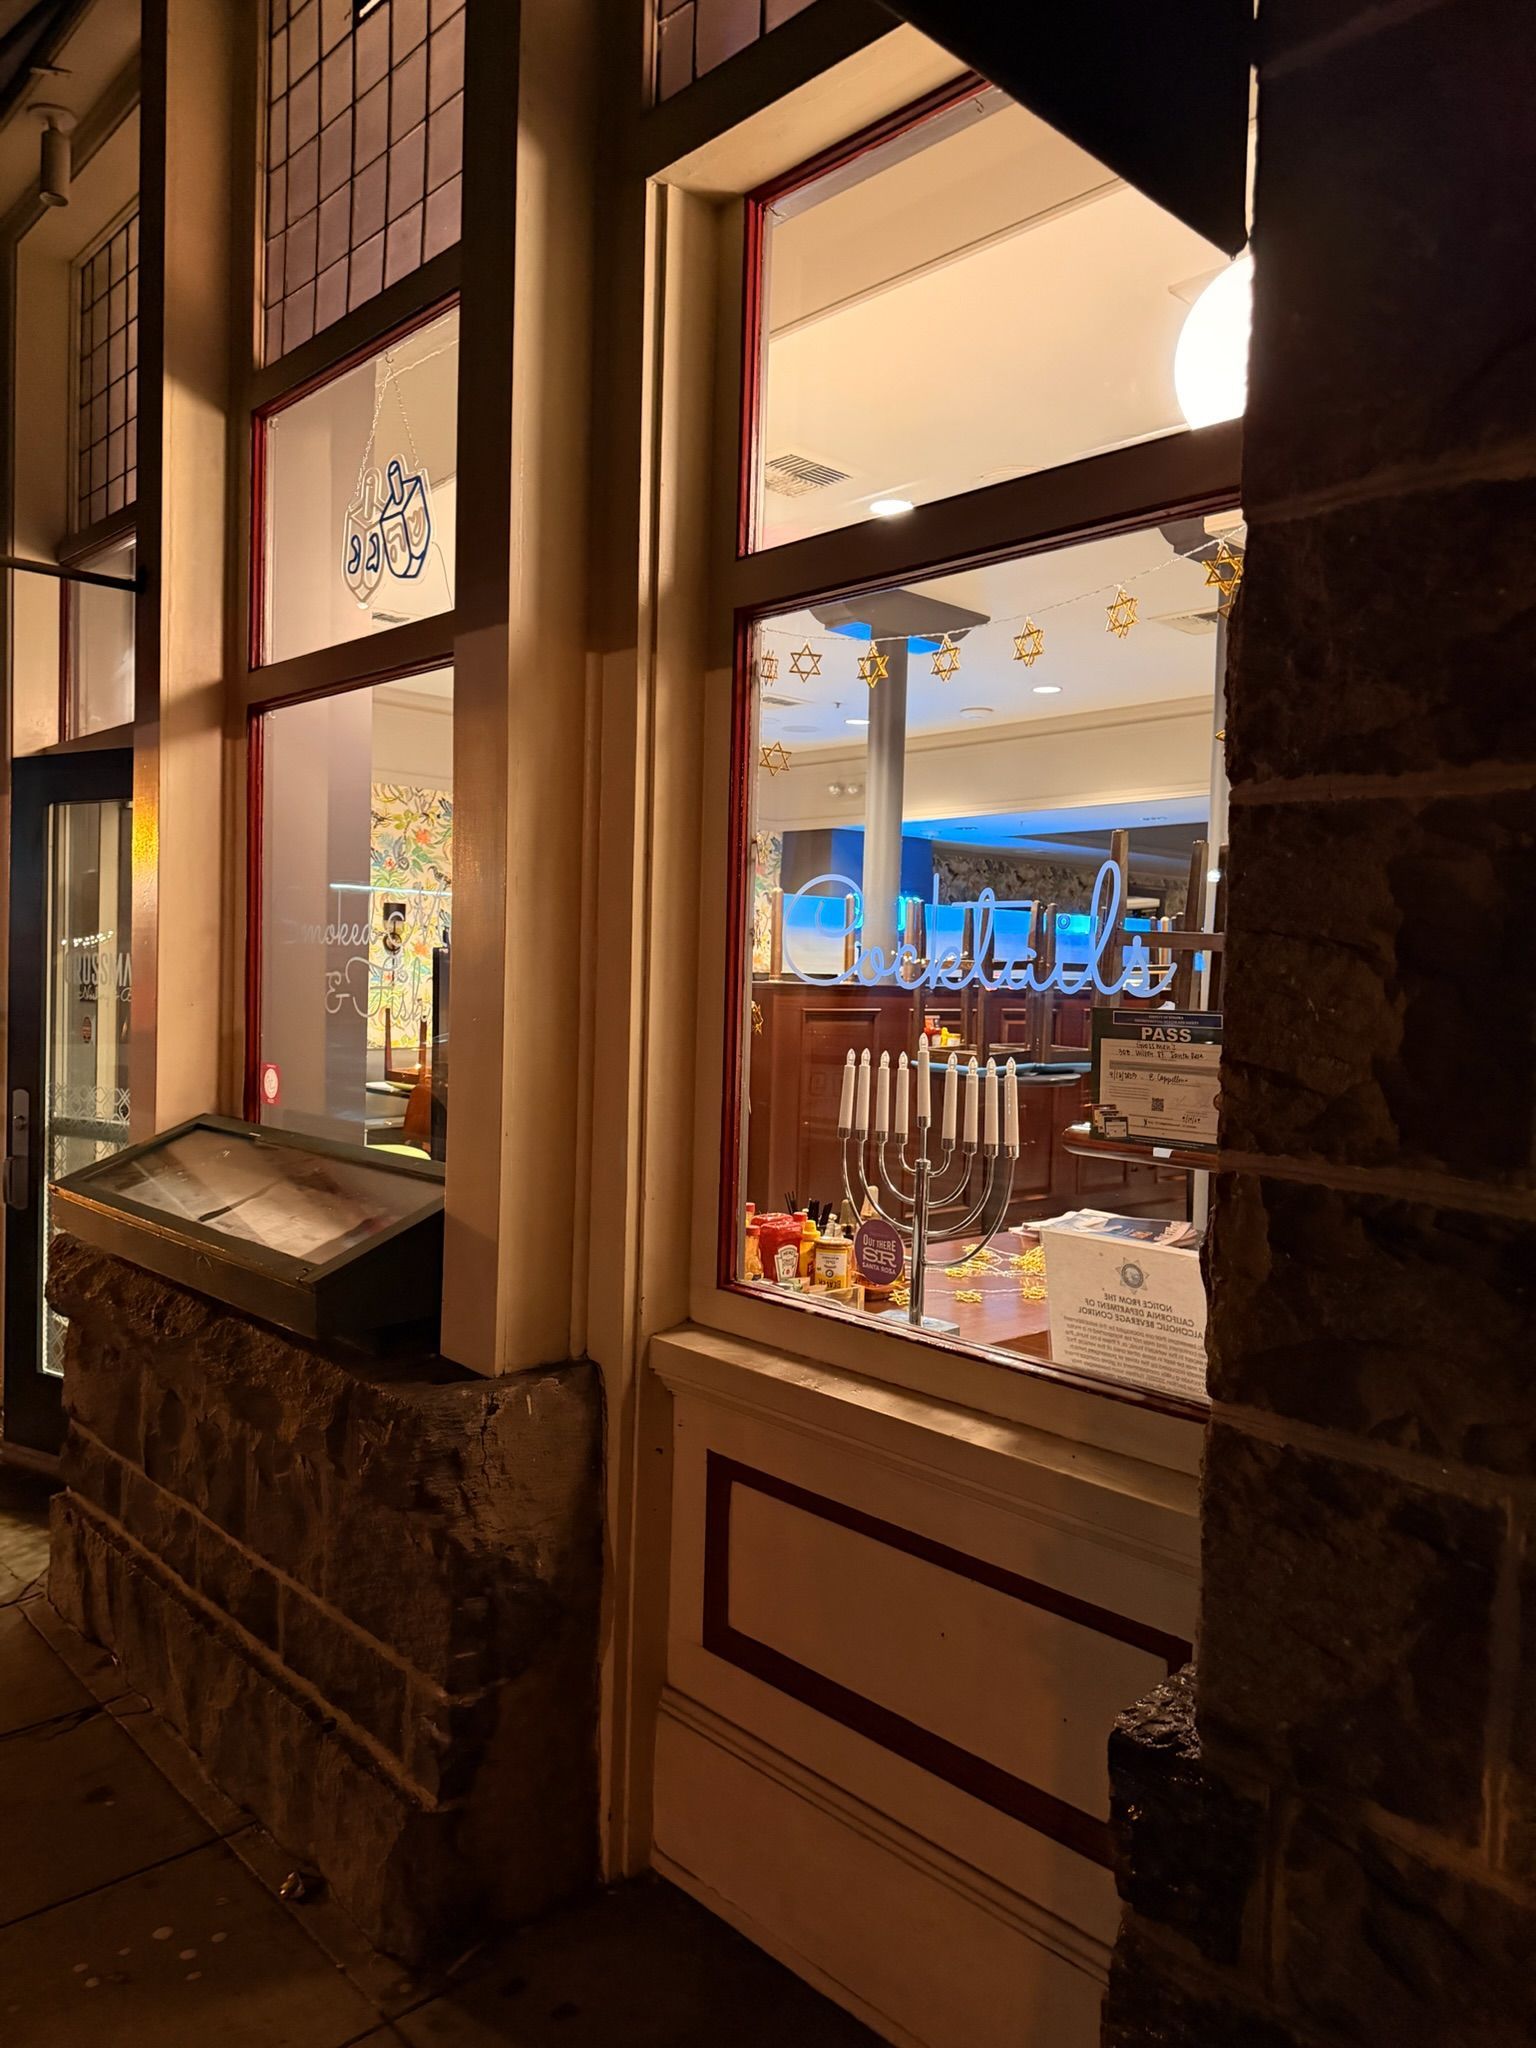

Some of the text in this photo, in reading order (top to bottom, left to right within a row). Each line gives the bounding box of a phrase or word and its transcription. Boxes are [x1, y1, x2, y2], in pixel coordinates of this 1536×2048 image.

[784, 860, 1177, 998] Cocktails
[1141, 1027, 1192, 1043] PASS
[862, 1233, 897, 1252] OUT THERE
[862, 1246, 897, 1268] SR
[862, 1262, 897, 1275] SANTA ROSA
